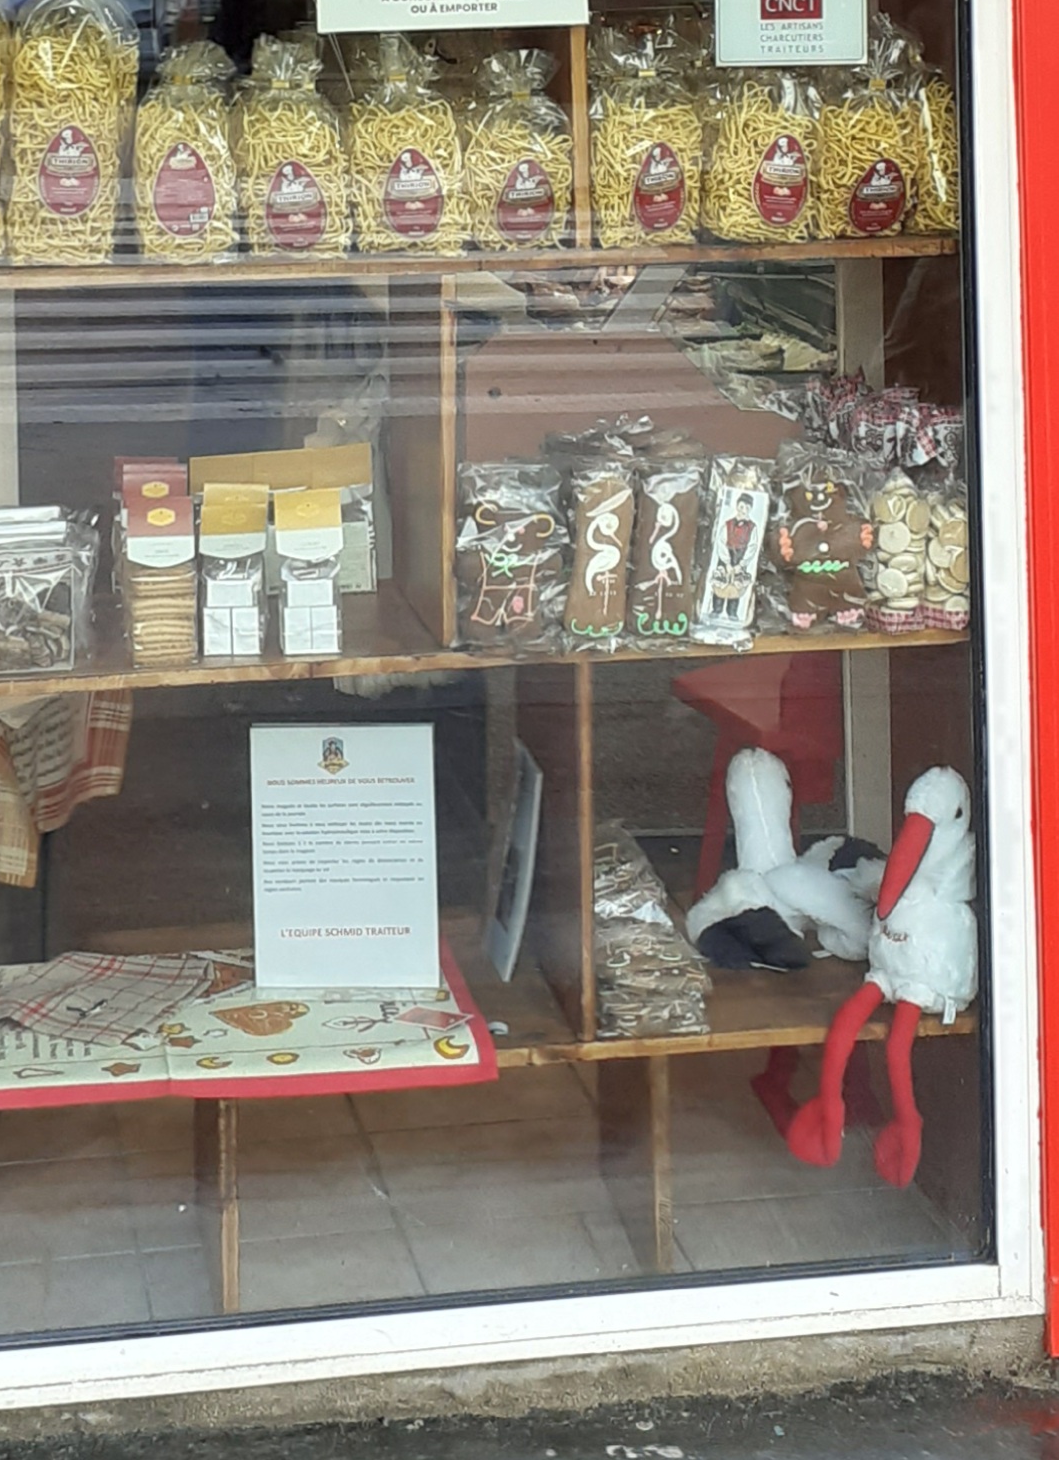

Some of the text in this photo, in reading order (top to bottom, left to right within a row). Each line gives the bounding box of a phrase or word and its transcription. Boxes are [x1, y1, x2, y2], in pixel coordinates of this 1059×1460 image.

[411, 5, 428, 14] OU
[440, 3, 497, 13] EMPORTER
[760, 23, 824, 31] LES ARTISANS
[760, 33, 824, 42] CHARCUTIERS
[760, 45, 824, 54] TRAITEURS
[325, 927, 363, 937] SCHMID
[364, 926, 411, 936] TRAITEUR
